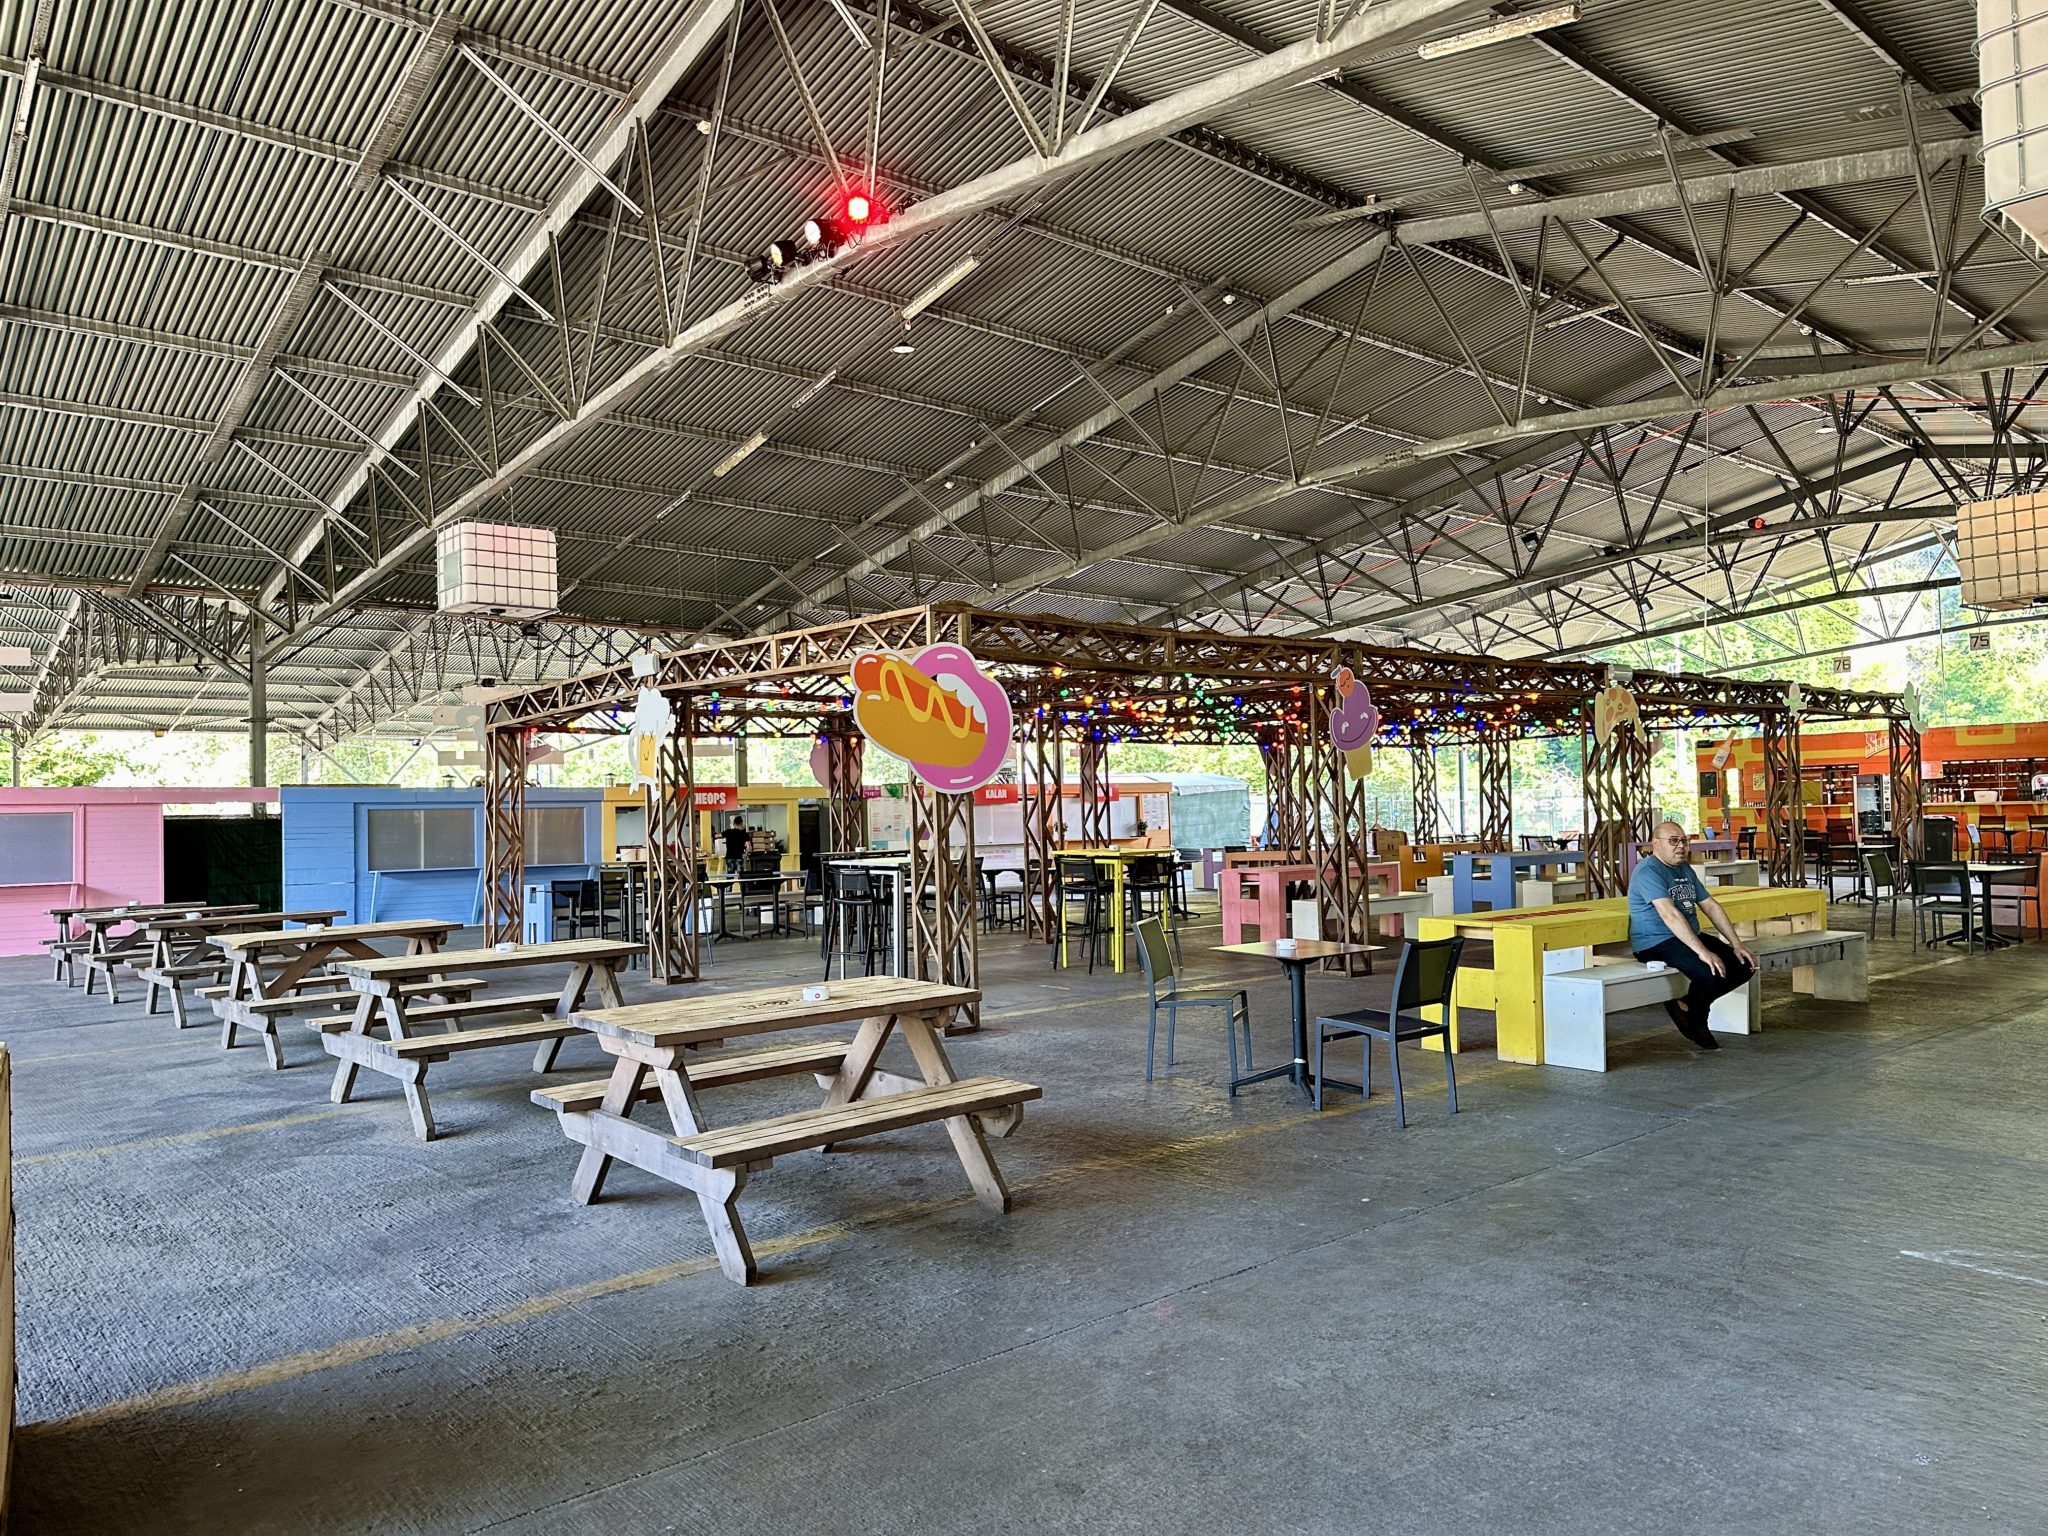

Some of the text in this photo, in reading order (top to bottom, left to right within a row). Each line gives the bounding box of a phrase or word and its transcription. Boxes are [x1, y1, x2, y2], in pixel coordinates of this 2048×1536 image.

[1971, 635, 1990, 648] 75
[1835, 659, 1850, 671] 76
[694, 792, 726, 805] HEOPS
